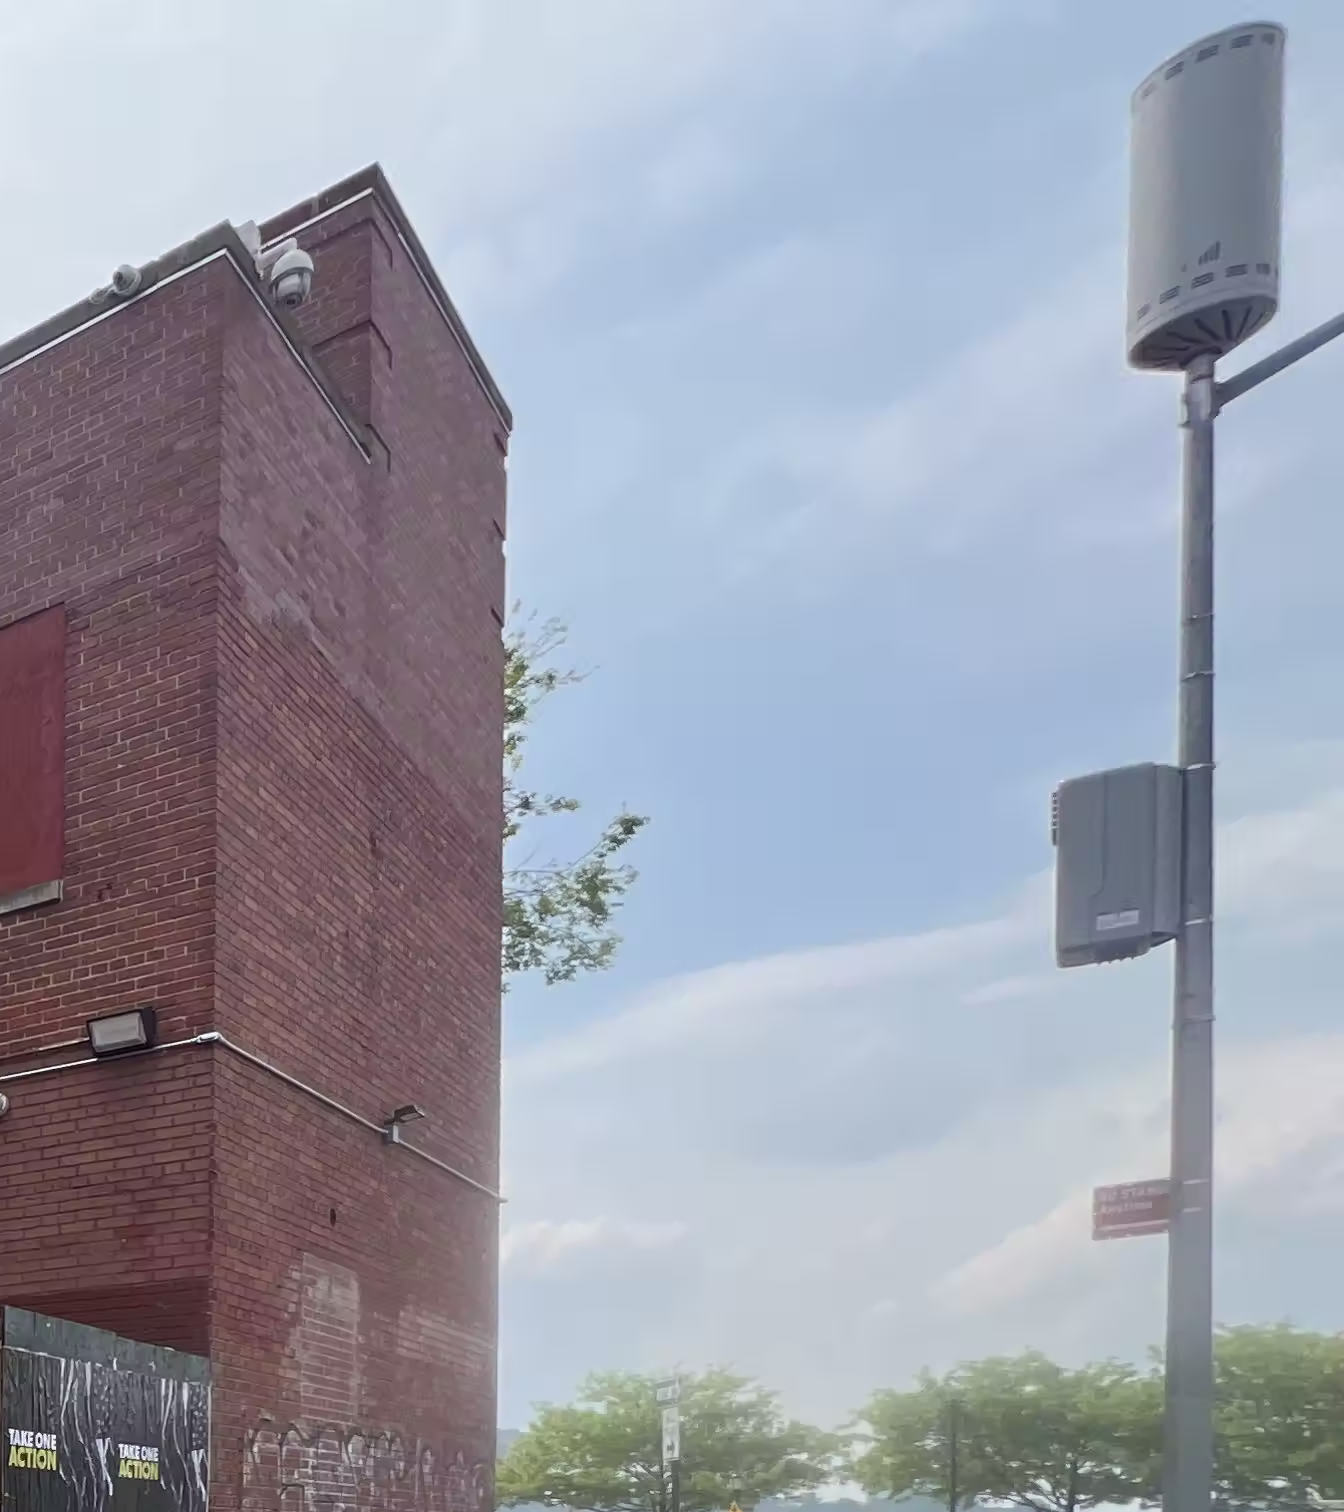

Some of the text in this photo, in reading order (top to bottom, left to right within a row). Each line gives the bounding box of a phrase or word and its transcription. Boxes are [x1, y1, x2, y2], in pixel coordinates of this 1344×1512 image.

[8, 1428, 56, 1450] TAKE ONE
[8, 1446, 56, 1470] ACTION
[118, 1443, 158, 1461] TAKE ONE
[118, 1459, 158, 1480] ACTION
